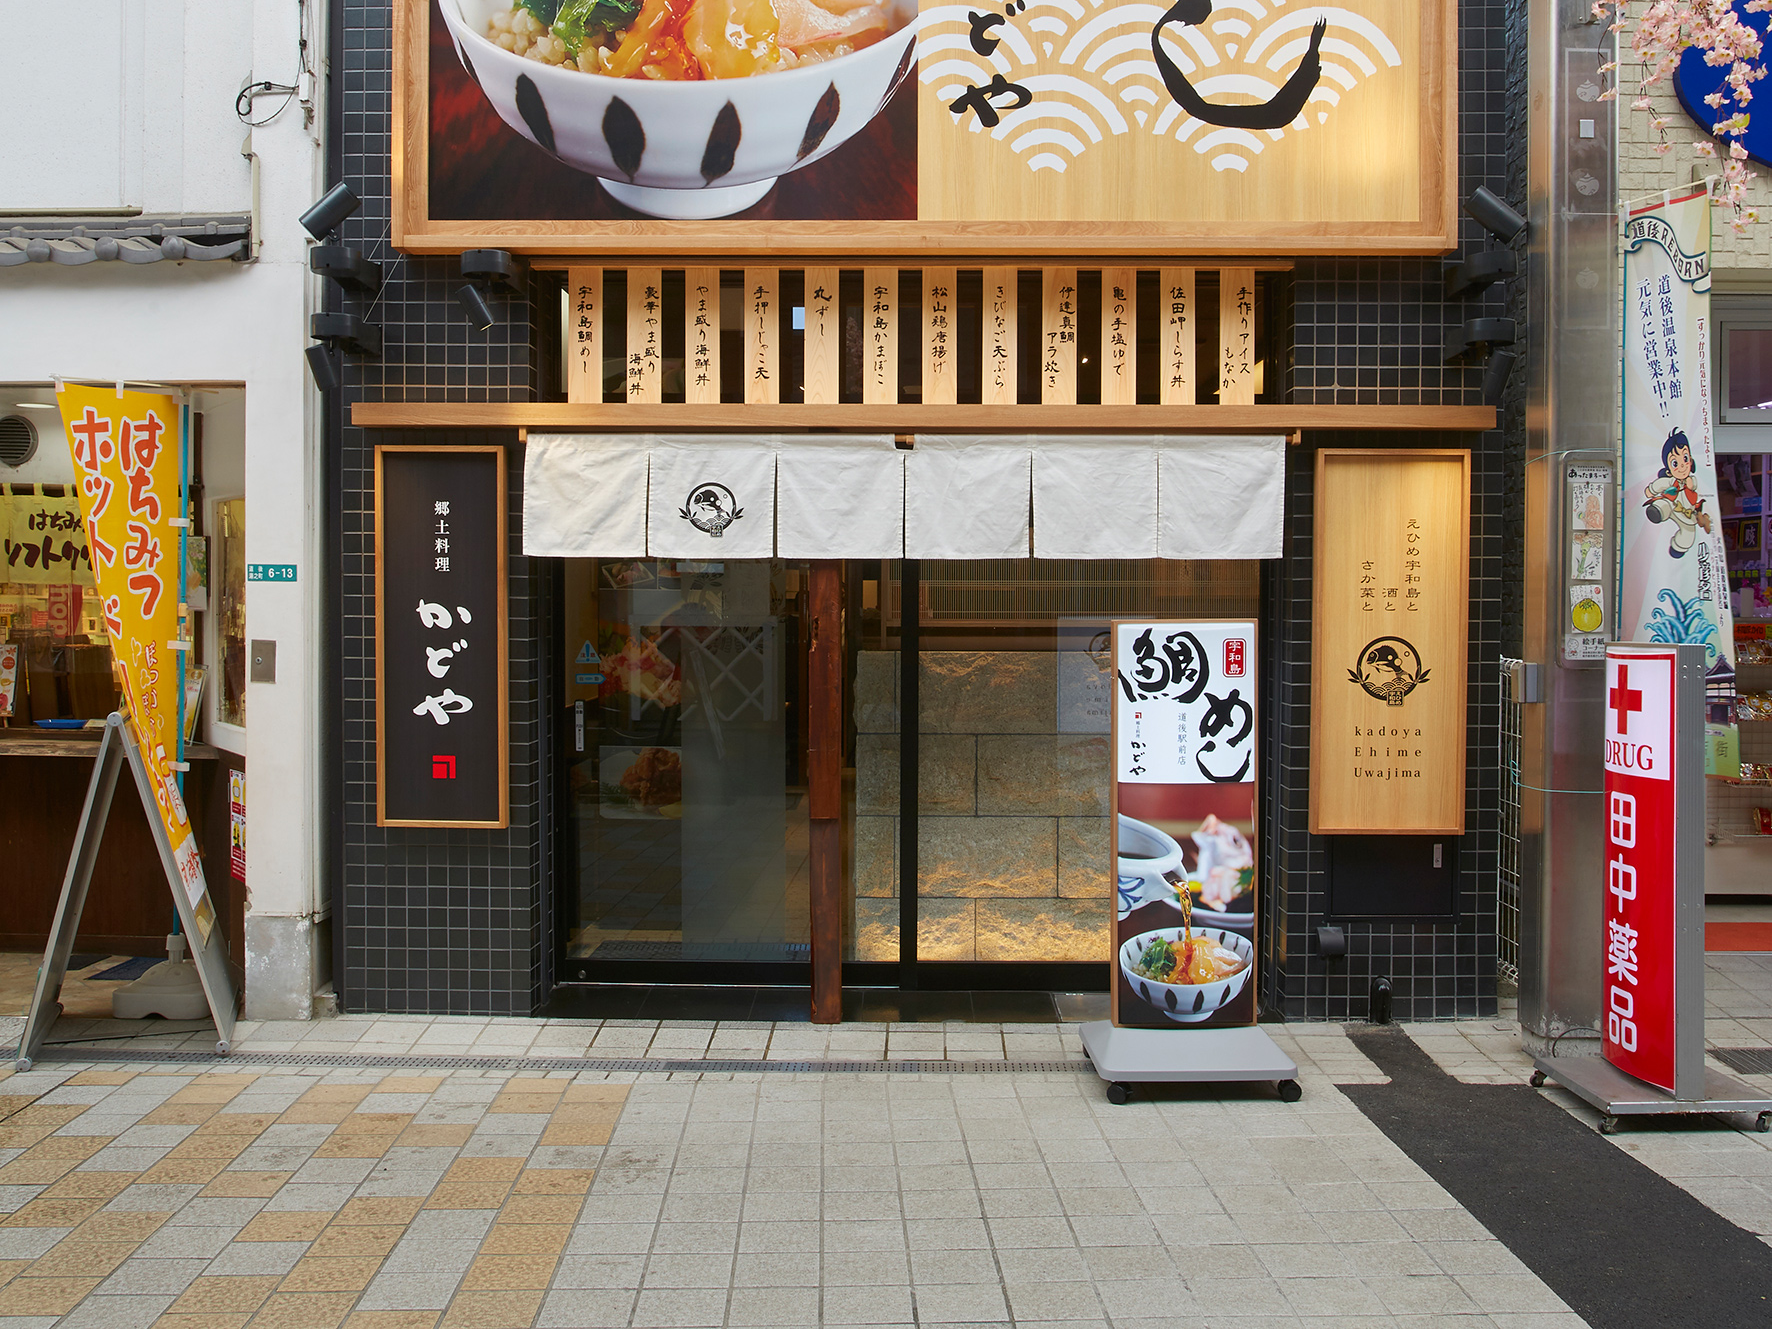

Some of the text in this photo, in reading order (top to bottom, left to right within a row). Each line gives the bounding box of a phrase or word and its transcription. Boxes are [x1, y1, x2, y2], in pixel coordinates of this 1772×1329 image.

[577, 285, 594, 374] 宇和島鯛めし
[643, 285, 660, 374] 豪華やま盛り
[694, 285, 711, 387] やま盛り海鮮丼
[753, 285, 770, 380] 手押しじゃこ天
[813, 285, 832, 337] 丸ずし
[872, 285, 890, 385] 宇和島かまぼこ
[931, 285, 948, 374] 松山鶏唐揚げ
[992, 285, 1008, 388] きびなご天ぷら
[1059, 285, 1075, 343] 伊達真鯛
[1111, 285, 1127, 376] 亀の手塩ゆで
[1170, 285, 1186, 388] 佐田岬しらす丼
[1236, 285, 1253, 375] 手作りアイス
[1657, 274, 1683, 400] 道後温泉本館
[628, 352, 645, 396] 海鮮丼
[1044, 331, 1060, 389] アラ炊き
[1222, 346, 1236, 389] もなか
[119, 409, 166, 620] はちみつ
[434, 500, 451, 572] 郷土料理
[268, 568, 293, 578] 6-13
[1360, 559, 1376, 613] さか菜と
[1382, 587, 1399, 613] 酒と
[1404, 517, 1421, 613] えひめ宇和島と
[412, 598, 474, 726] かどや
[1228, 641, 1242, 675] 宇和島
[1582, 637, 1605, 645] 絵手紙
[1117, 627, 1253, 783] 鯛めし
[1177, 712, 1188, 766] 道後駅前店
[1354, 725, 1422, 740] kadoya
[1129, 741, 1147, 776] かどや
[1353, 766, 1421, 780] Uwajima
[1354, 746, 1422, 757] Ehime
[1605, 738, 1653, 771] DRUG
[1608, 790, 1639, 1053] 田中薬品
